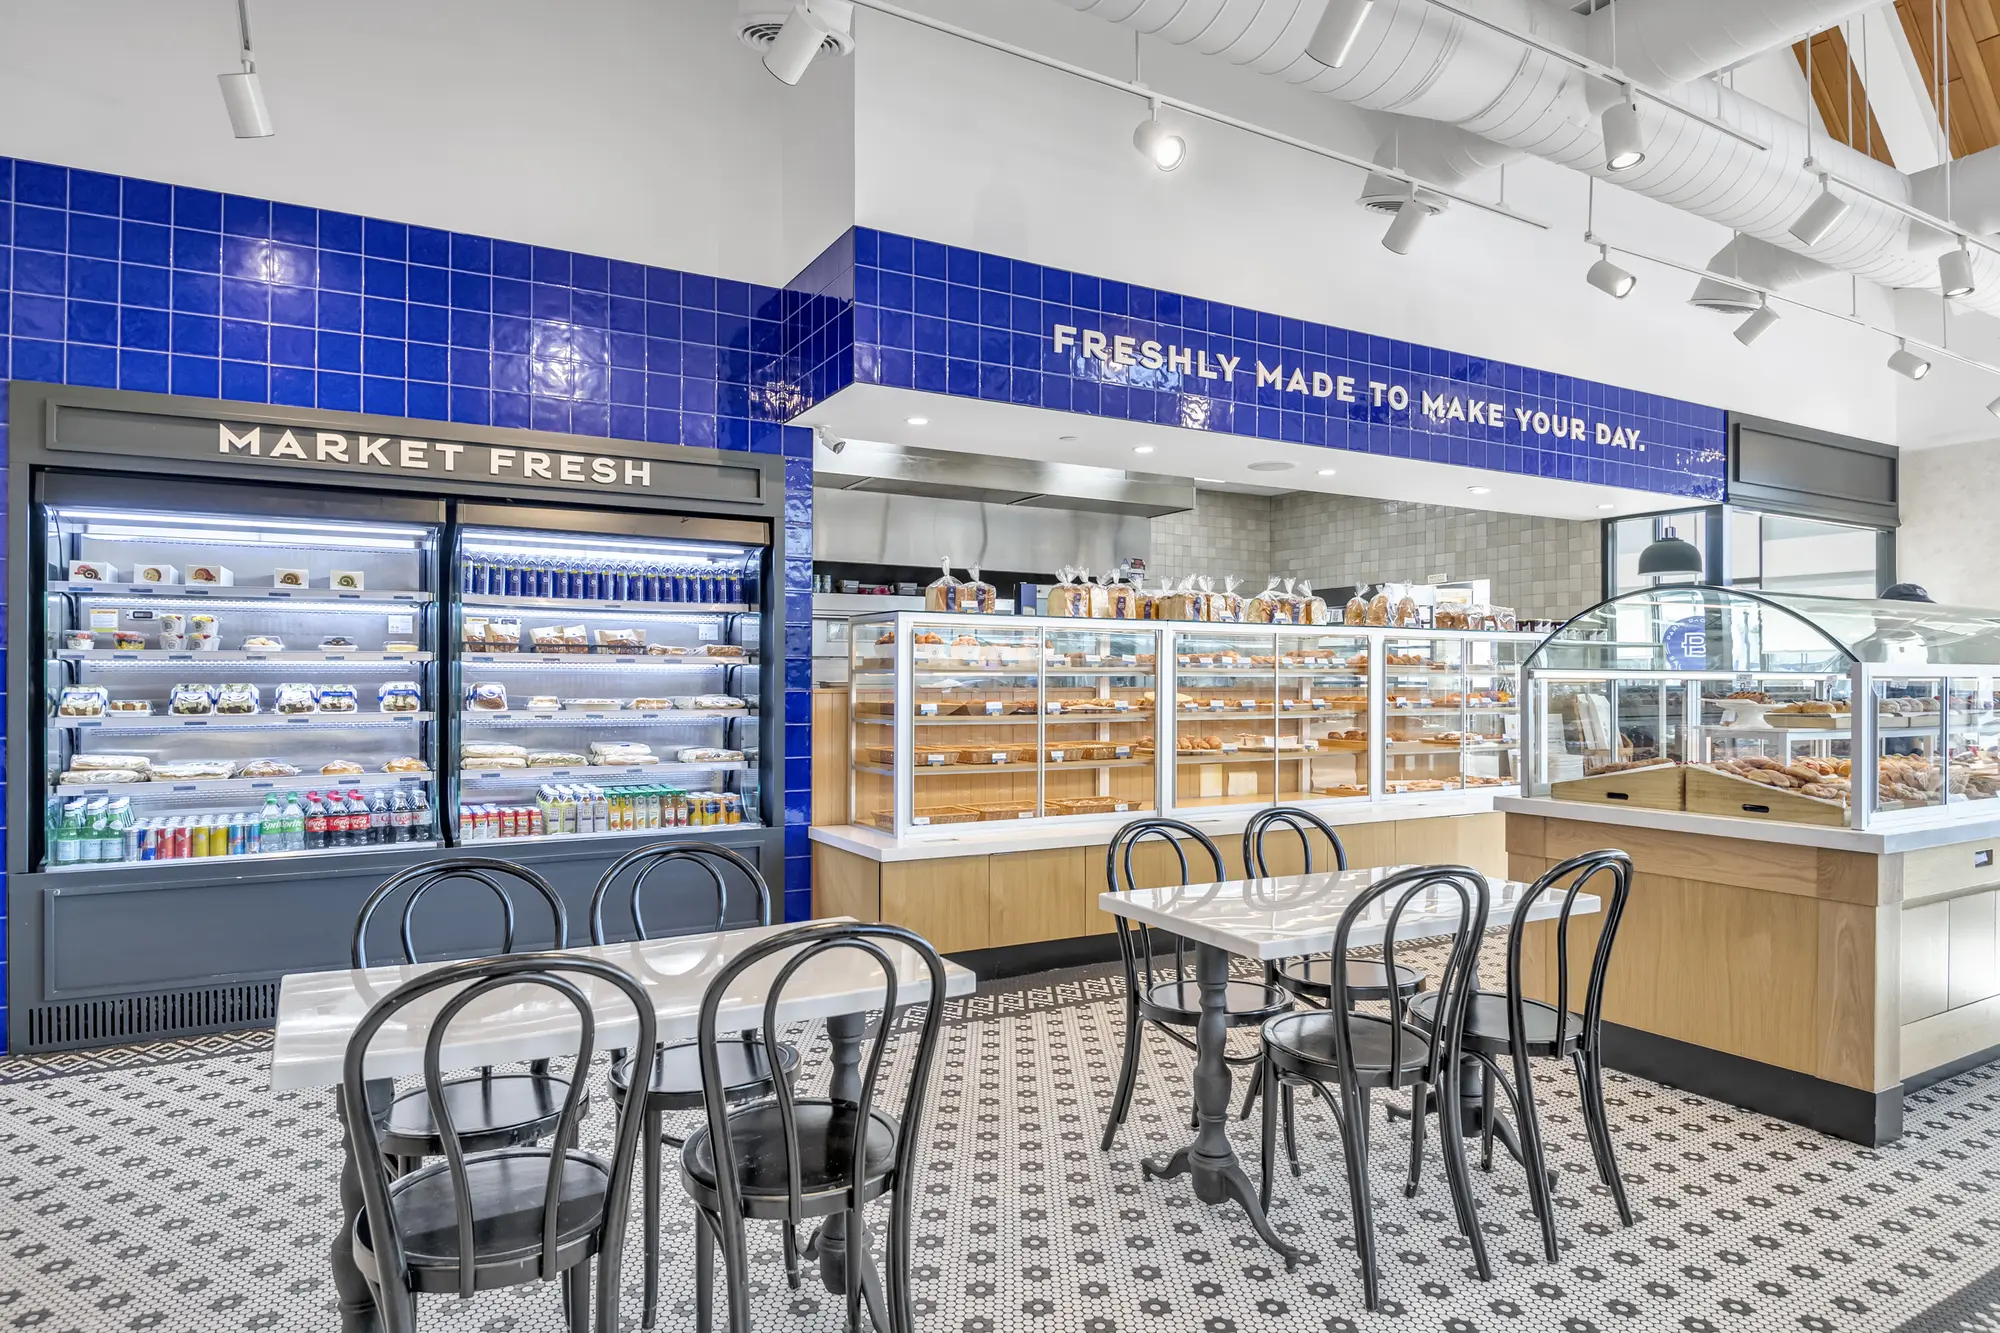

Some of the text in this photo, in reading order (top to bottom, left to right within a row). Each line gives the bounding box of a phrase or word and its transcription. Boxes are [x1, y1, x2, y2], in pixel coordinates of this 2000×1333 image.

[1053, 323, 1646, 452] FRESHLY MADE TO MAKE YOUR DAY.
[218, 423, 652, 487] MARKET FRESH
